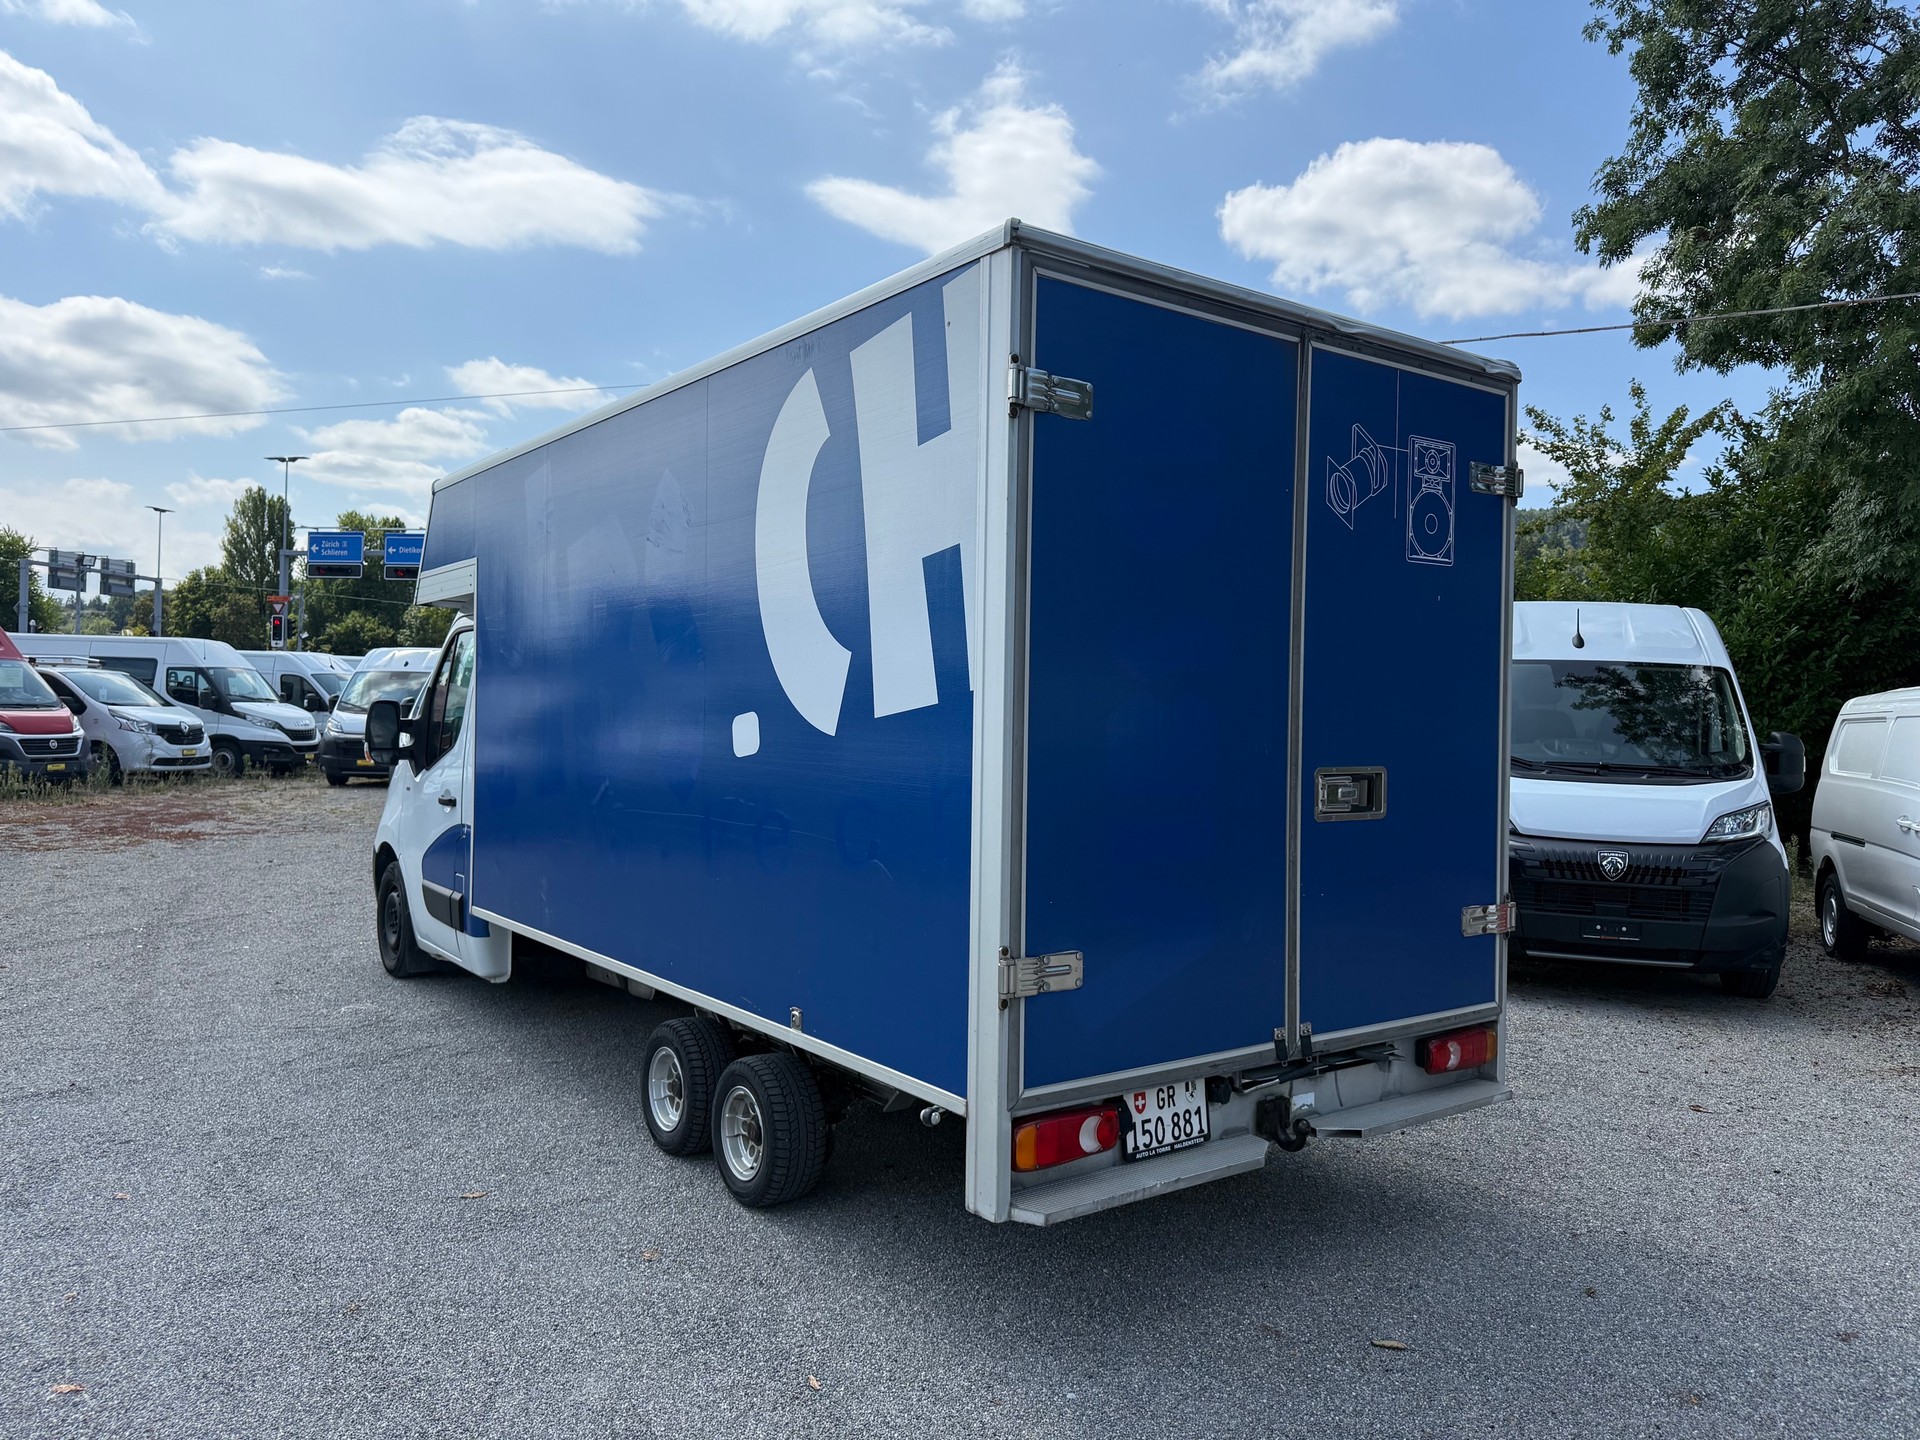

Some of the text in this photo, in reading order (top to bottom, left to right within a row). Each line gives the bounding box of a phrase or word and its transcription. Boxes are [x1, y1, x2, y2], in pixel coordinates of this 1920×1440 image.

[321, 540, 340, 548] Zürich
[320, 548, 348, 556] Schlieren
[1156, 1085, 1176, 1110] GR
[1131, 1105, 1205, 1152] 150 881
[1135, 1151, 1149, 1159] AUTO
[1156, 1146, 1172, 1154] TORRE
